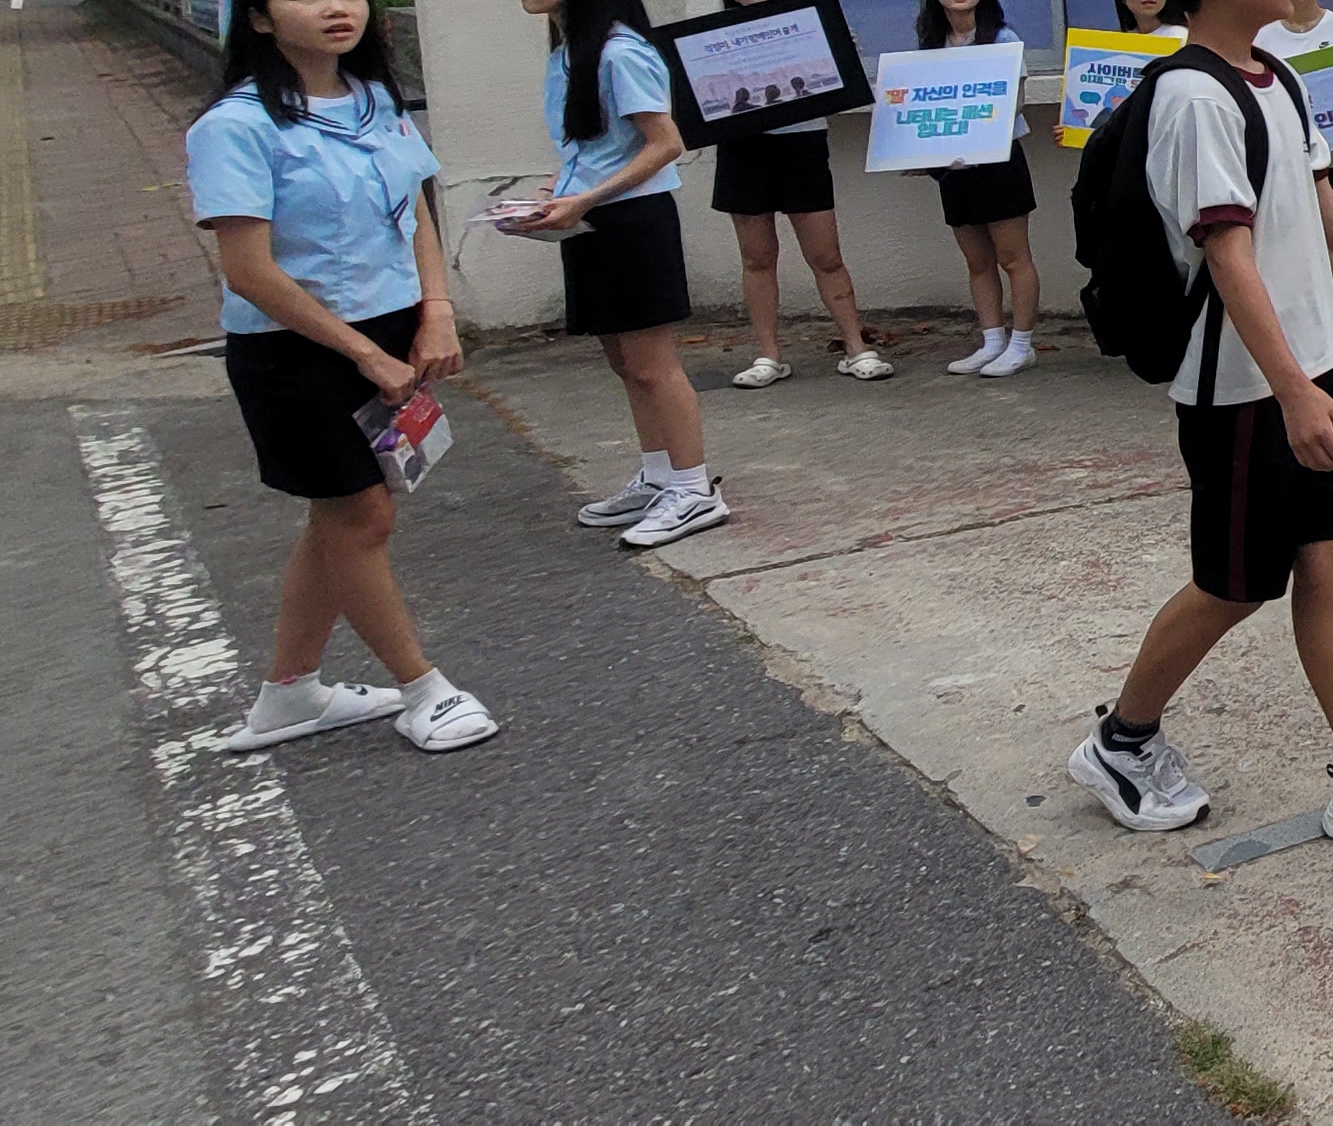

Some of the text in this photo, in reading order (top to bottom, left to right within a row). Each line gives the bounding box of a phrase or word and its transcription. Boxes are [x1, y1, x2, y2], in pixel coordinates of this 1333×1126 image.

[911, 84, 959, 102] 자신의
[962, 80, 1008, 98] 인격을
[896, 106, 959, 125] 나타내는
